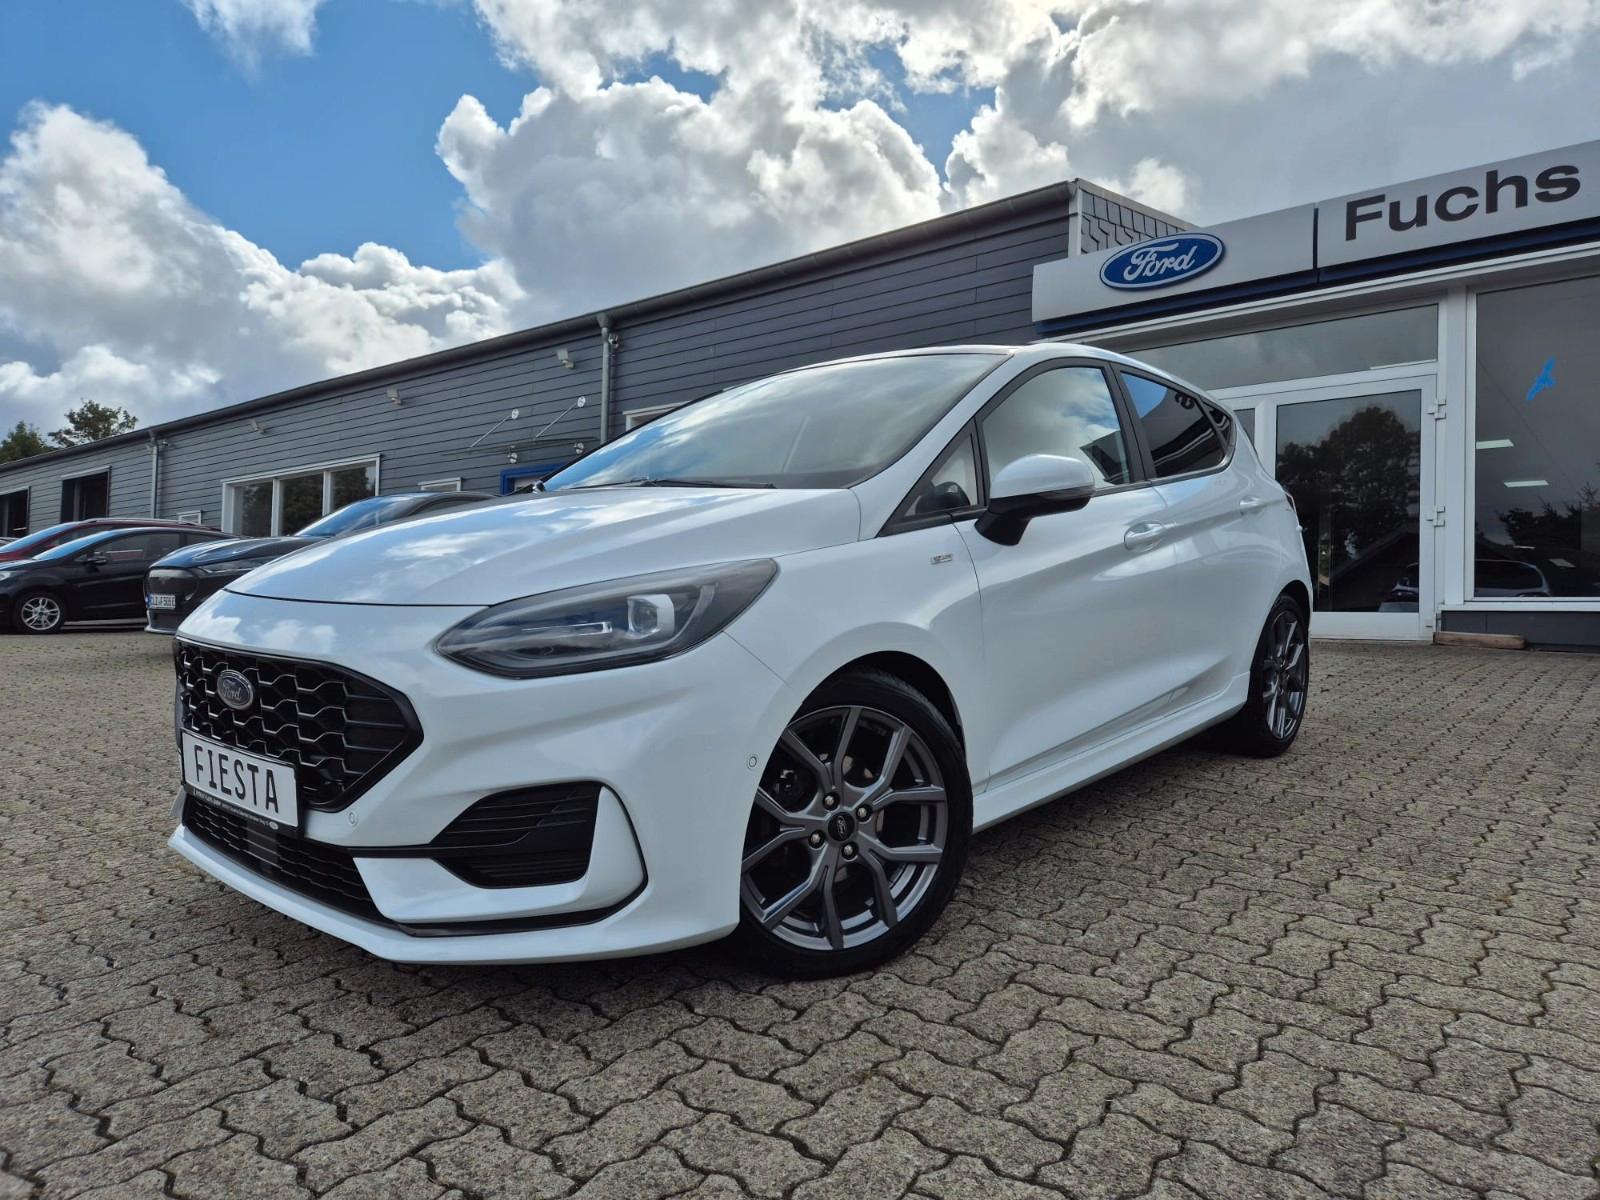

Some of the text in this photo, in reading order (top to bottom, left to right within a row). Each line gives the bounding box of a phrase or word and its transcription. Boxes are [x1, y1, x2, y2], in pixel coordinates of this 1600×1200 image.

[1345, 164, 1580, 241] Fuchs
[1122, 245, 1196, 282] Ford
[193, 744, 279, 814] FIESTA
